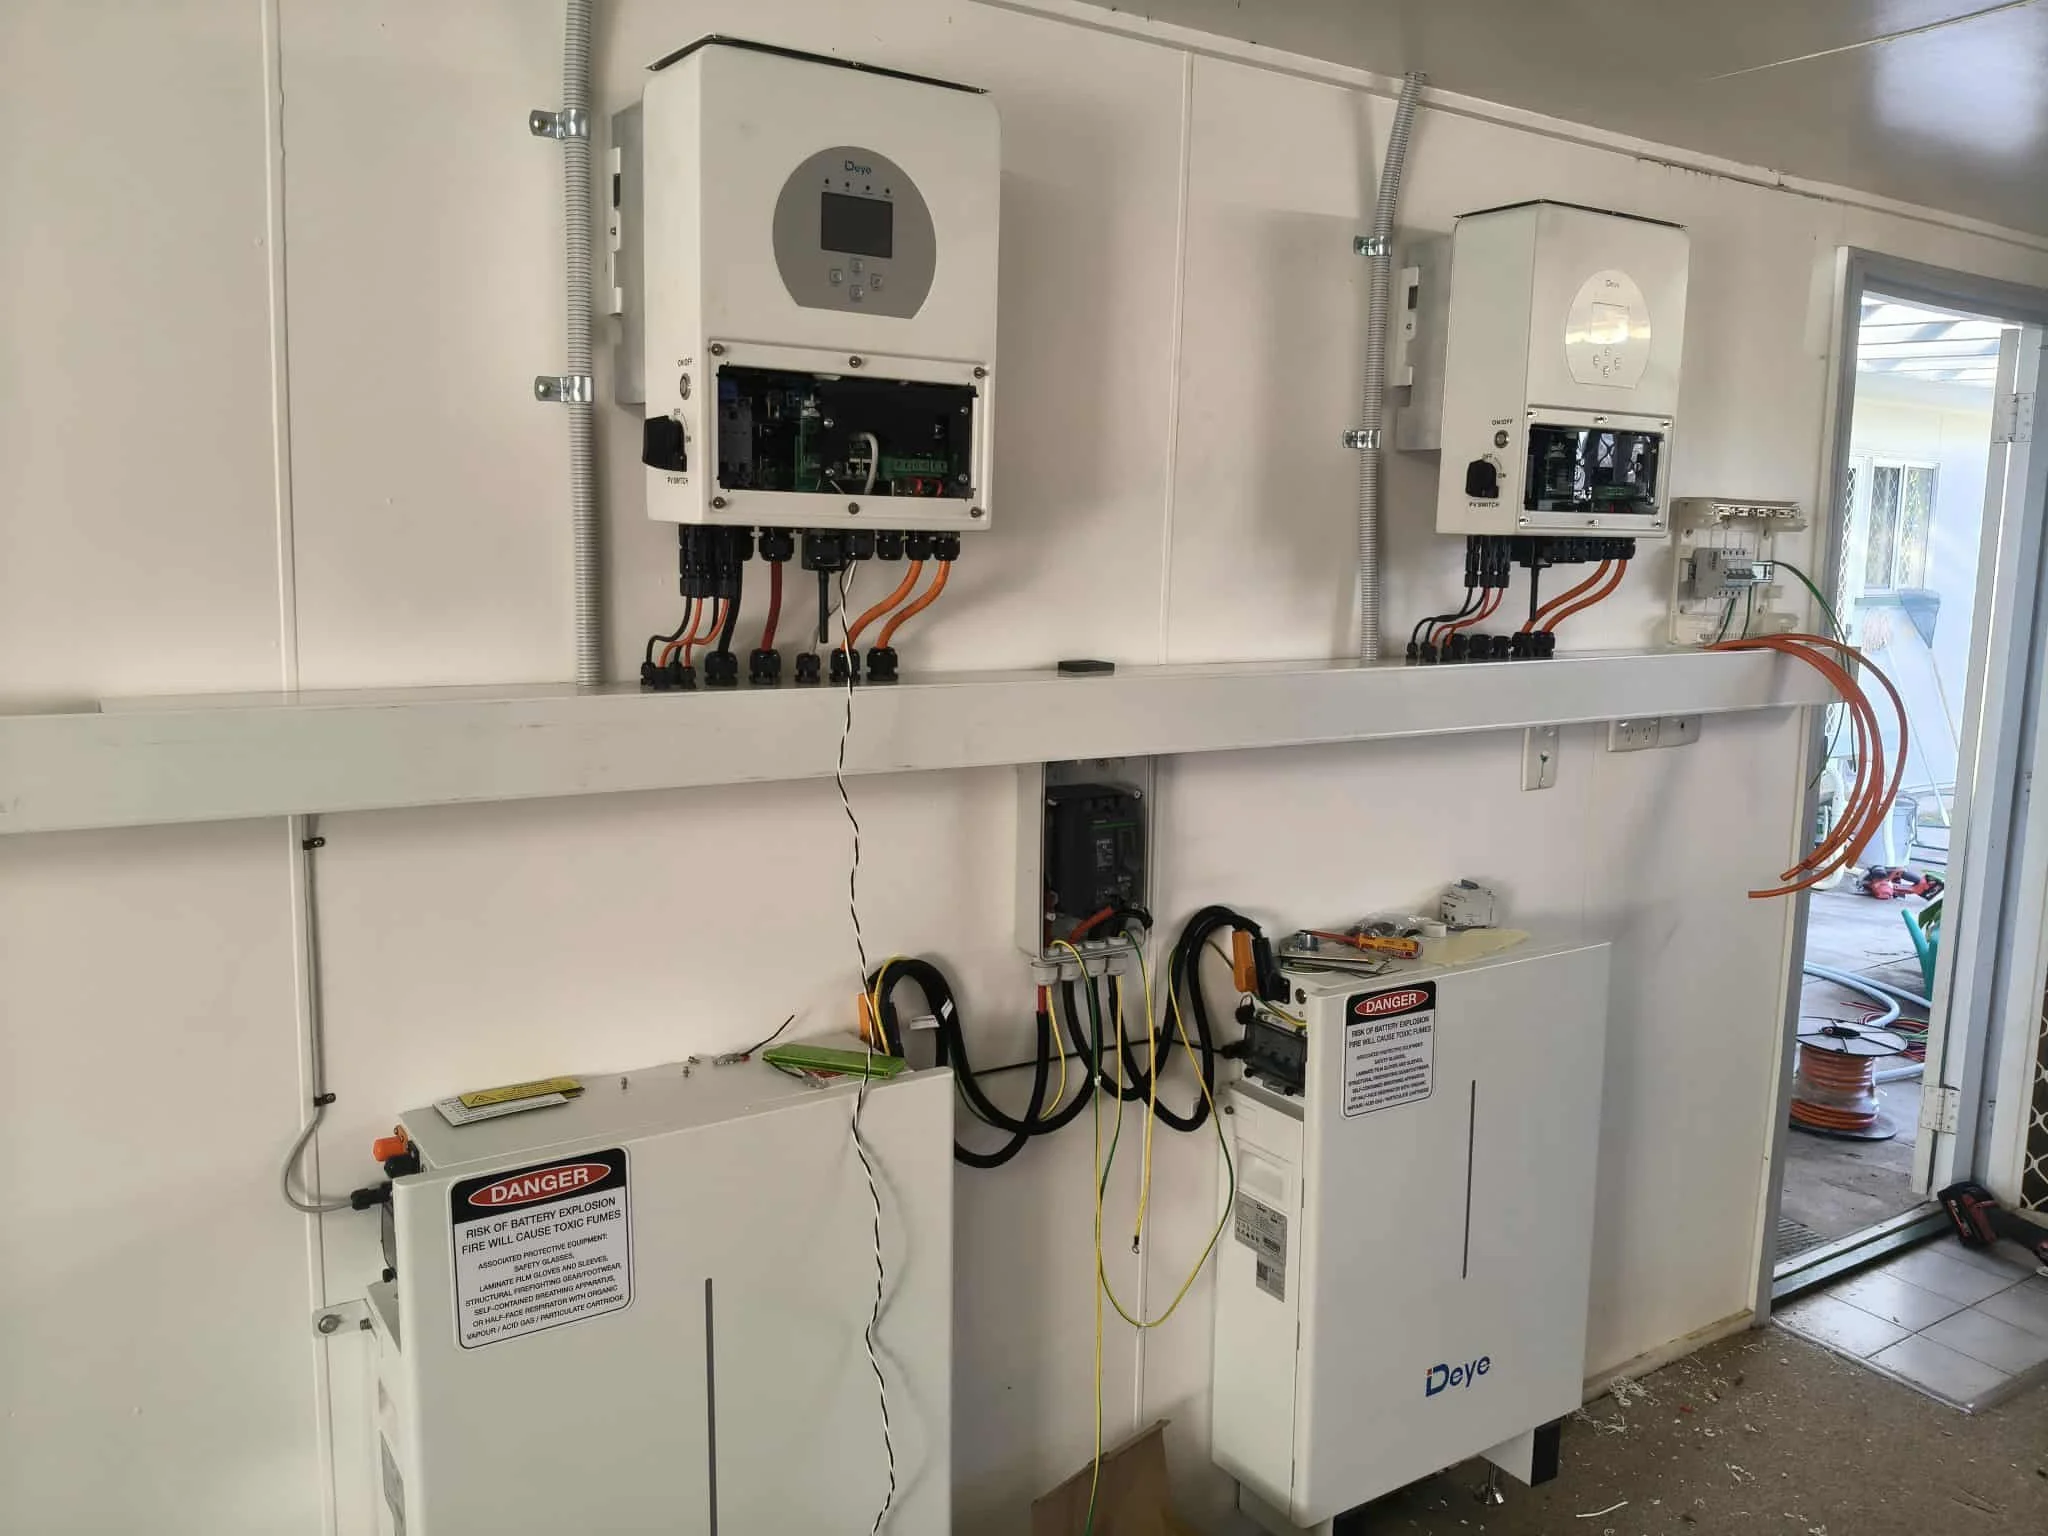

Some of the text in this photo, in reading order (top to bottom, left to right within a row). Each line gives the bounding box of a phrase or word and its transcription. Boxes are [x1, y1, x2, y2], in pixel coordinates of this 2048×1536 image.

[1366, 993, 1417, 1013] DANGER
[1352, 1028, 1365, 1038] RISK
[1366, 1026, 1374, 1035] OF
[1374, 1022, 1398, 1033] BATTERY
[491, 1168, 589, 1203] DANGER
[462, 1210, 621, 1255] FIRE WILL CAUSE TOXIC FUMES
[466, 1197, 616, 1239] RISK OF BATTERY EXPLOSION
[478, 1254, 522, 1270] ASSOCIATED
[523, 1243, 565, 1258] PROTECTIVE
[514, 1260, 540, 1273] SAFETY
[465, 1289, 513, 1307] STRUCTURAL
[514, 1277, 561, 1294] FIREFIGHTING
[479, 1277, 514, 1293] LAMINATE
[516, 1273, 532, 1283] FILM
[534, 1266, 560, 1278] GLOVES
[562, 1263, 577, 1273] AND
[473, 1285, 618, 1327] OR HALF-FACE RESPIRATOR WITH ORGANIC
[474, 1296, 534, 1316] SELF-CONTAINED
[535, 1286, 573, 1302] BREATHING
[502, 1320, 519, 1331] ACID
[520, 1315, 535, 1326] GAS
[541, 1302, 585, 1321] PARTICULATE
[587, 1294, 624, 1309] CARTRIDGE
[1425, 1356, 1490, 1397] Deye
